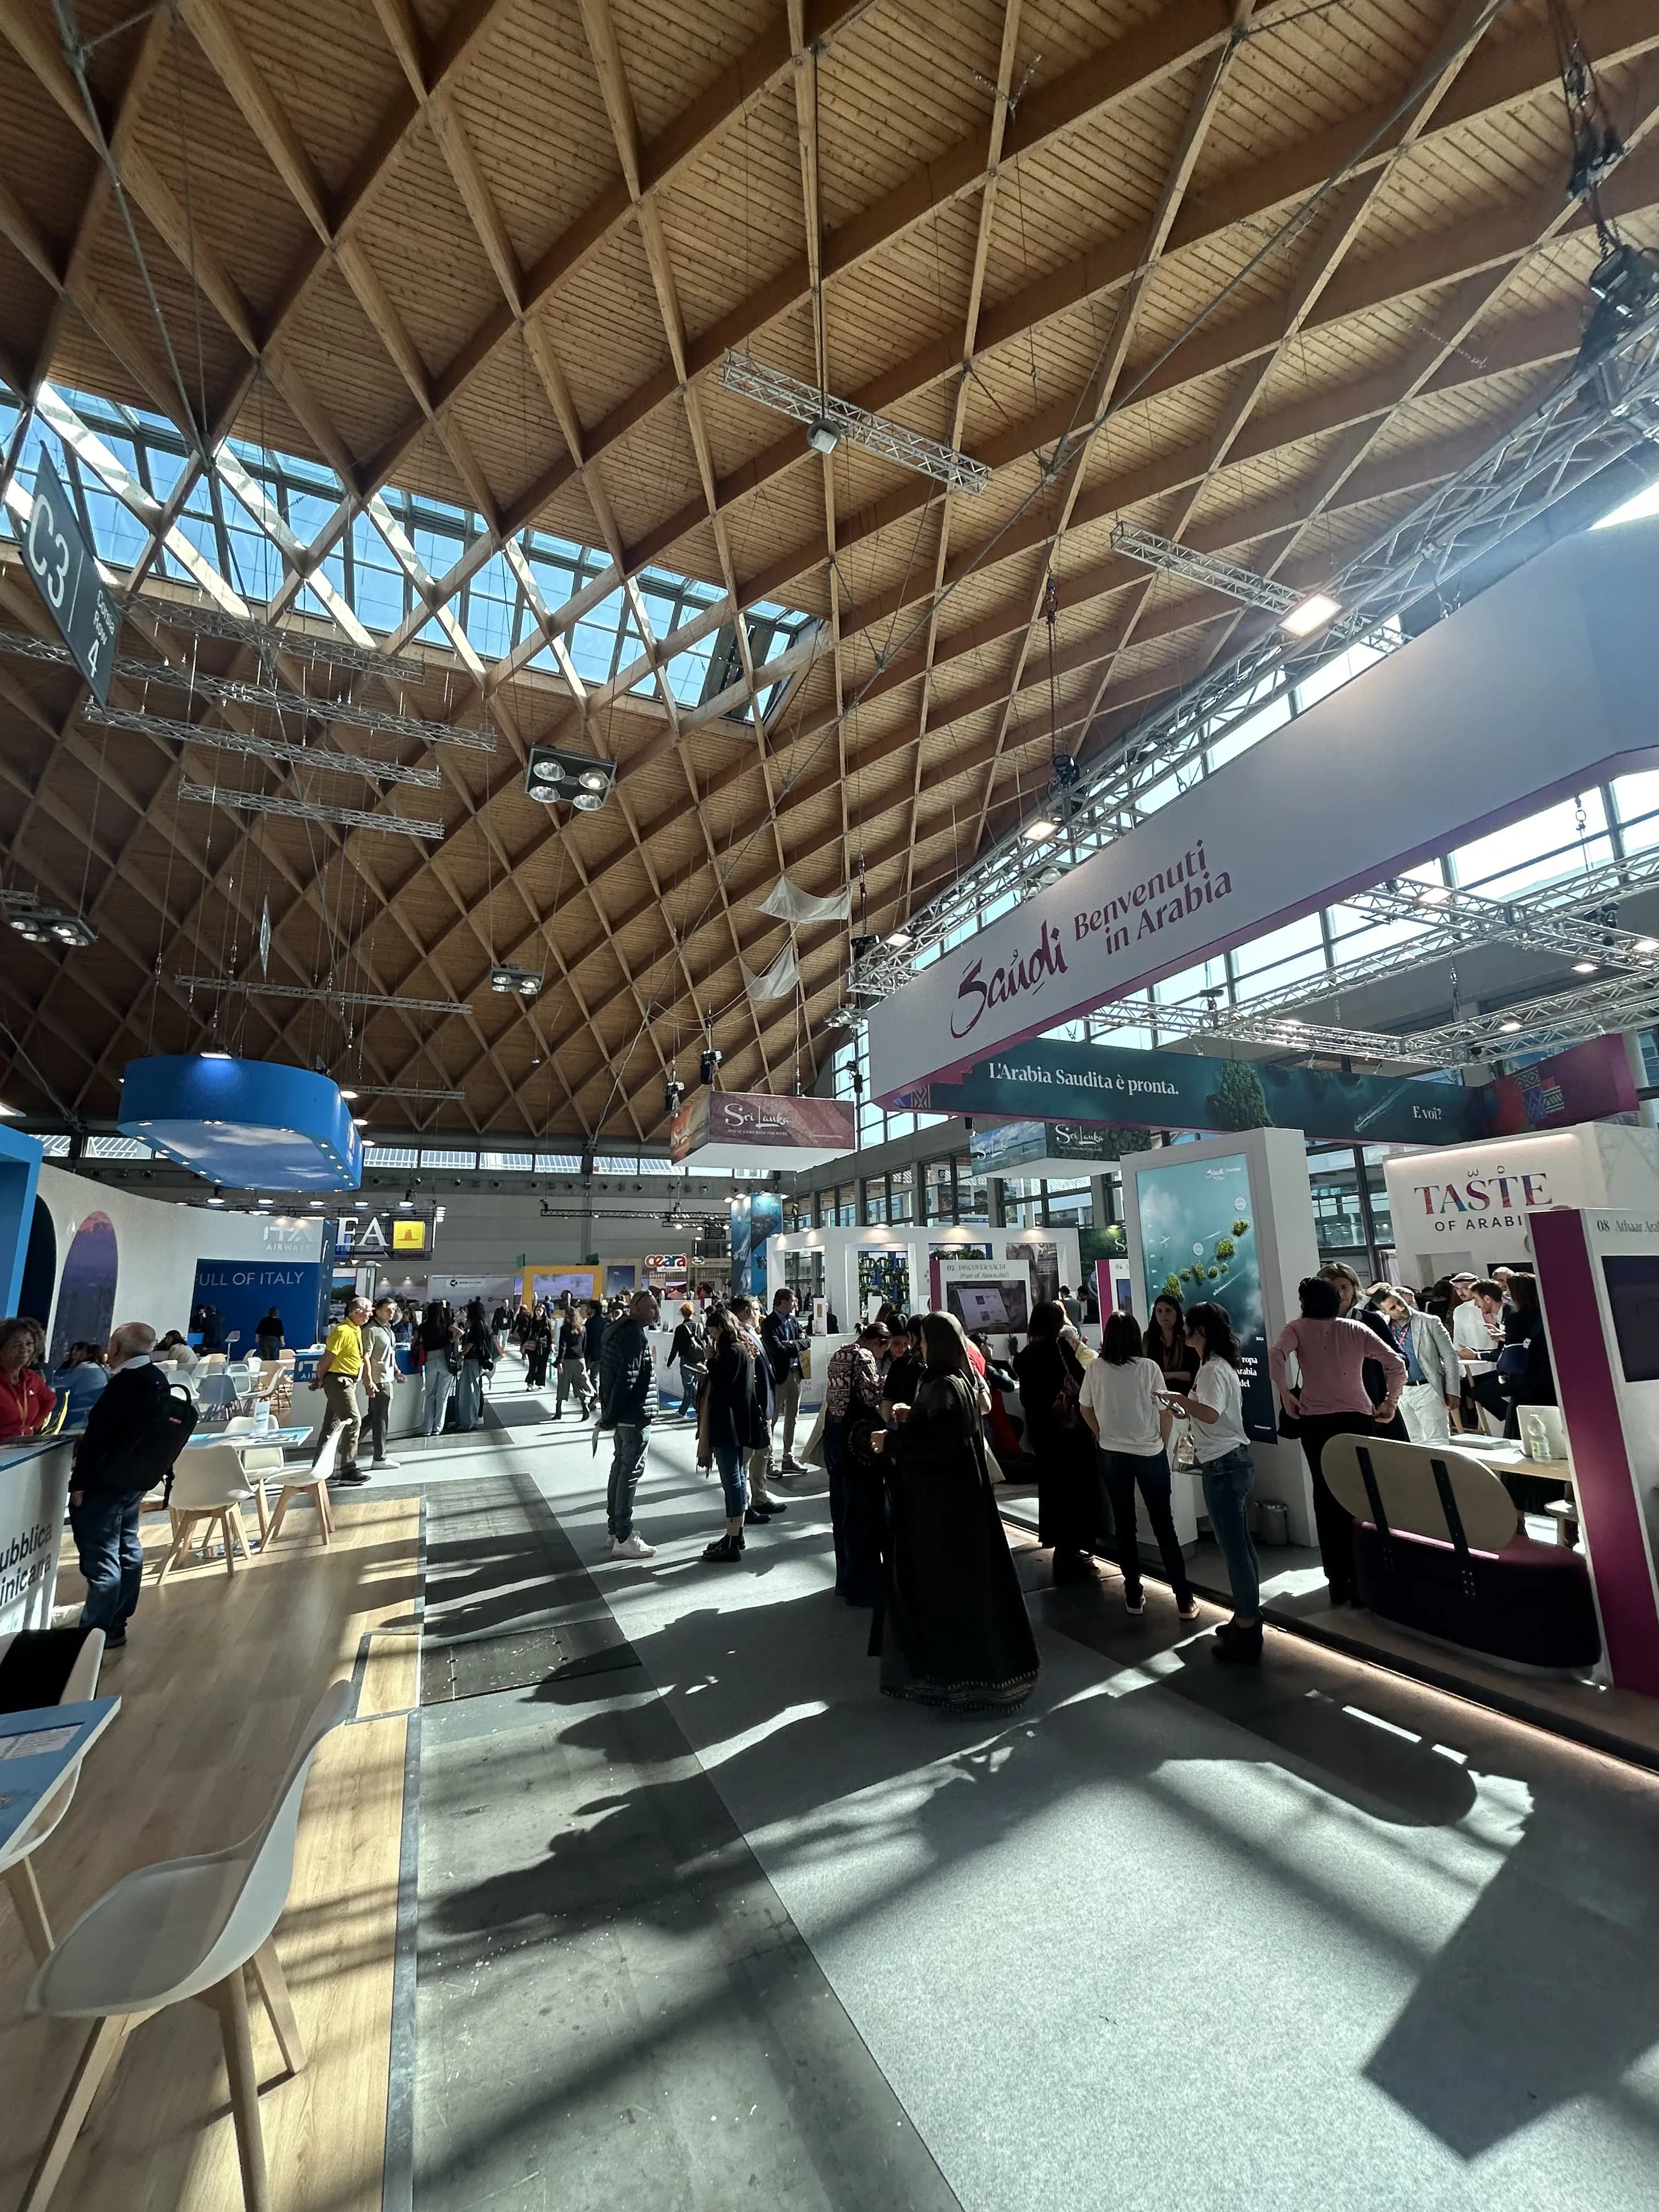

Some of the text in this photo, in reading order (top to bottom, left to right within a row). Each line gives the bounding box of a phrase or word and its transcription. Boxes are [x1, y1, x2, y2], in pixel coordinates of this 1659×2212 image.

[29, 494, 69, 607] C3
[93, 610, 108, 646] Row
[97, 590, 114, 634] Corsia
[88, 639, 99, 678] 4
[1074, 839, 1207, 941] Benvenuti
[1105, 871, 1233, 955] in Arabia
[951, 920, 1068, 1038] Saudi
[989, 1063, 1179, 1096] L'Arabia Saudita è pronta.
[724, 1103, 791, 1130] Sri Lanka
[1413, 1105, 1441, 1120] E voi?
[1055, 1124, 1103, 1145] Sri Lanka
[1414, 1172, 1553, 1215] TASTE
[263, 1226, 314, 1243] ITA
[335, 1217, 390, 1246] EA
[1435, 1215, 1522, 1232] OF ARABI
[1597, 1220, 1610, 1232] 08
[199, 1271, 304, 1286] ULL OF ITALY
[298, 1361, 319, 1372] IT
[1242, 1357, 1258, 1365] ropa
[0, 1523, 52, 1573] ubblica
[0, 1553, 51, 1607] inicana
